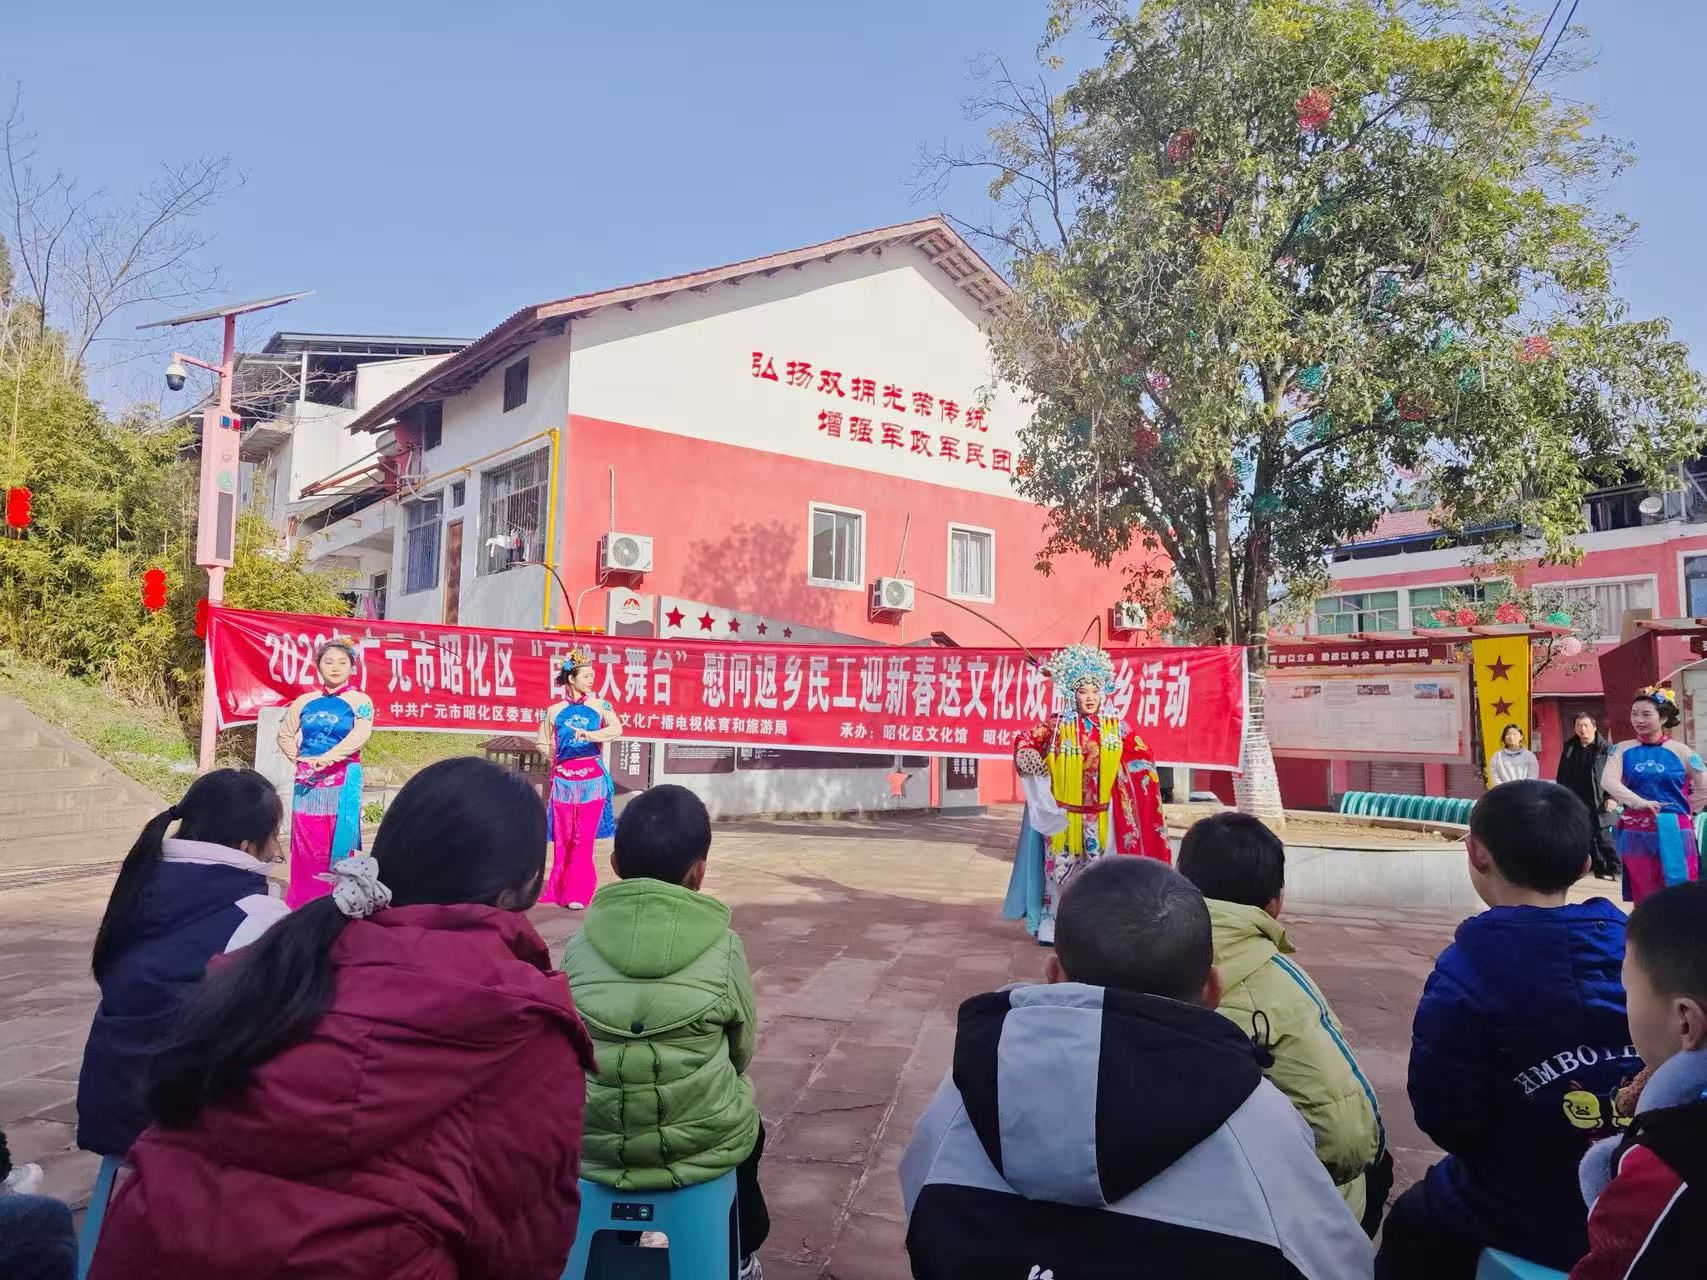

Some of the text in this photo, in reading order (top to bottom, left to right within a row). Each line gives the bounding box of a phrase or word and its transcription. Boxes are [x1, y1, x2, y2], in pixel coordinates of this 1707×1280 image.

[752, 352, 988, 432] 弘扬双拥光荣传统
